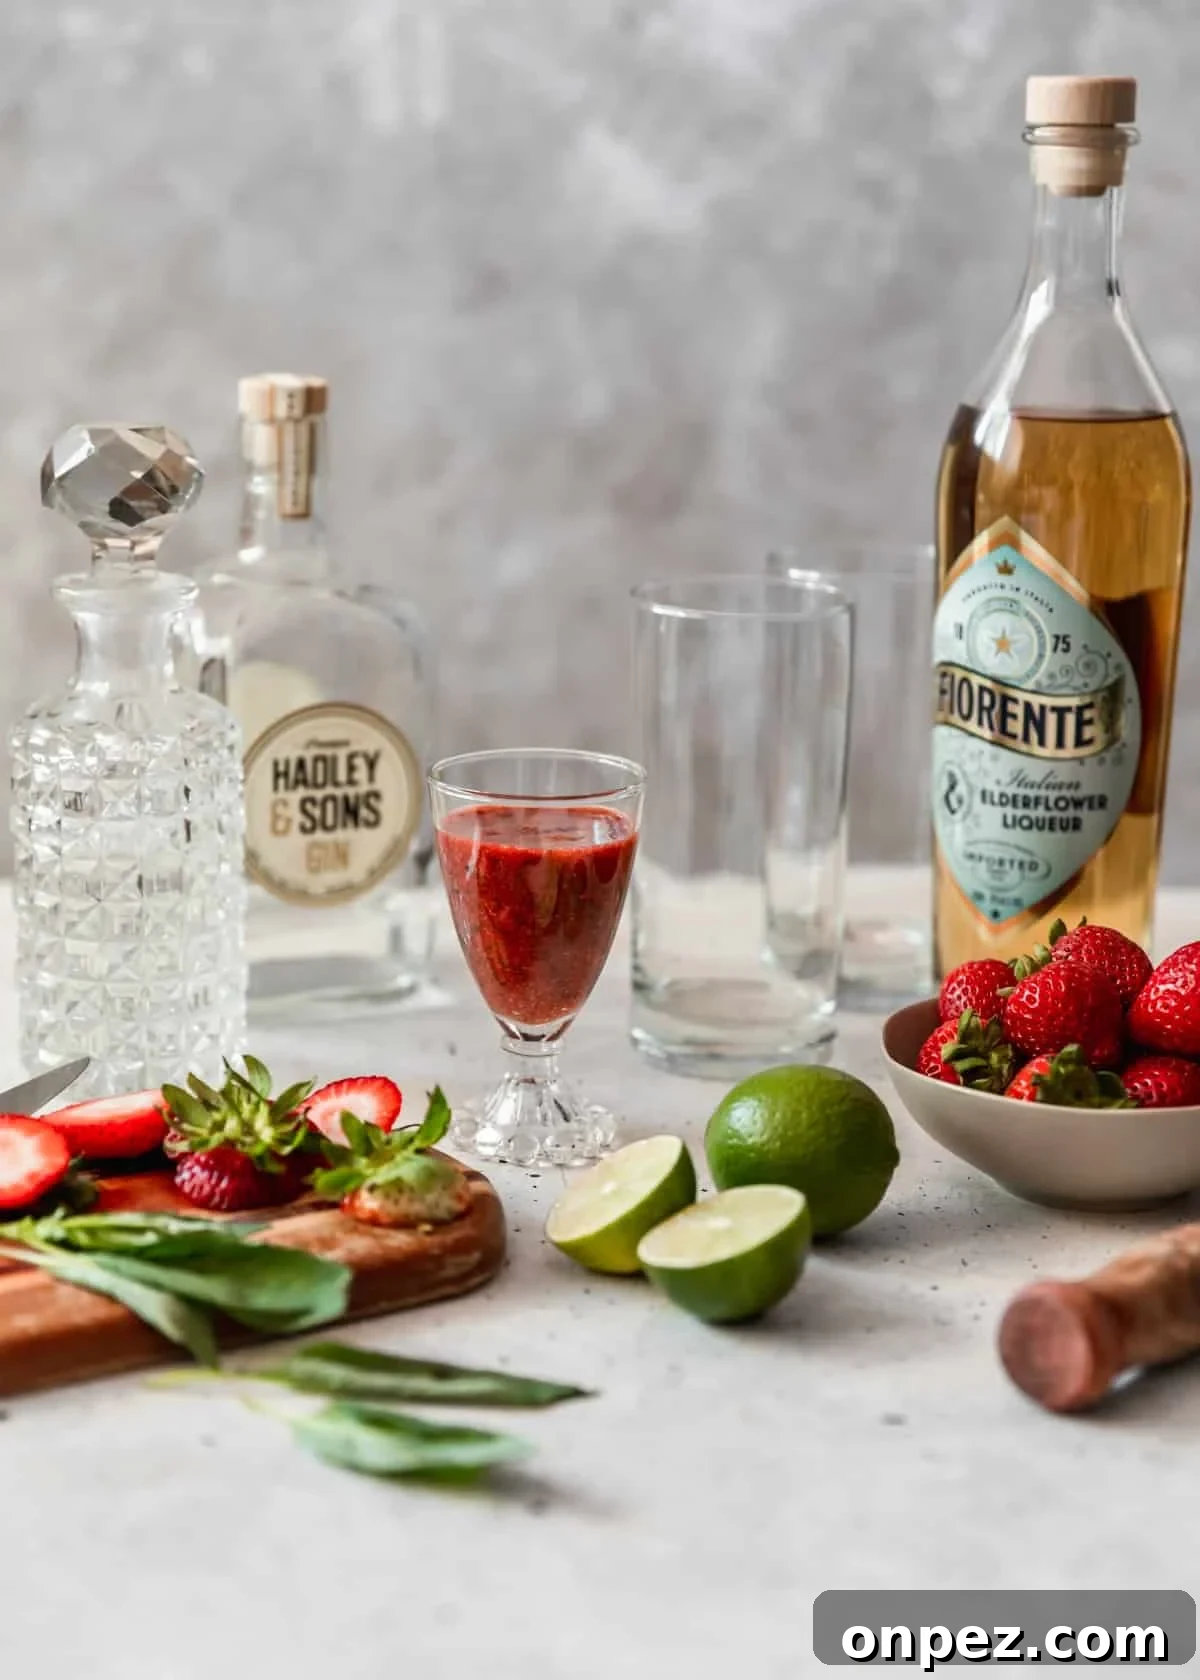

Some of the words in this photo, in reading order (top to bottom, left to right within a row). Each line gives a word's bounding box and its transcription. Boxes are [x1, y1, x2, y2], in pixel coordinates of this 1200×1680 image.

[1052, 634, 1071, 653] 75
[938, 671, 1095, 750] FIORENTE
[272, 750, 381, 792] HADLEY
[996, 767, 1081, 792] Italian
[270, 799, 292, 837] &
[299, 789, 382, 835] SONS
[981, 788, 1108, 812] ELDERFLOWER
[1002, 813, 1083, 832] LIQUEUR
[306, 841, 350, 873] GIN
